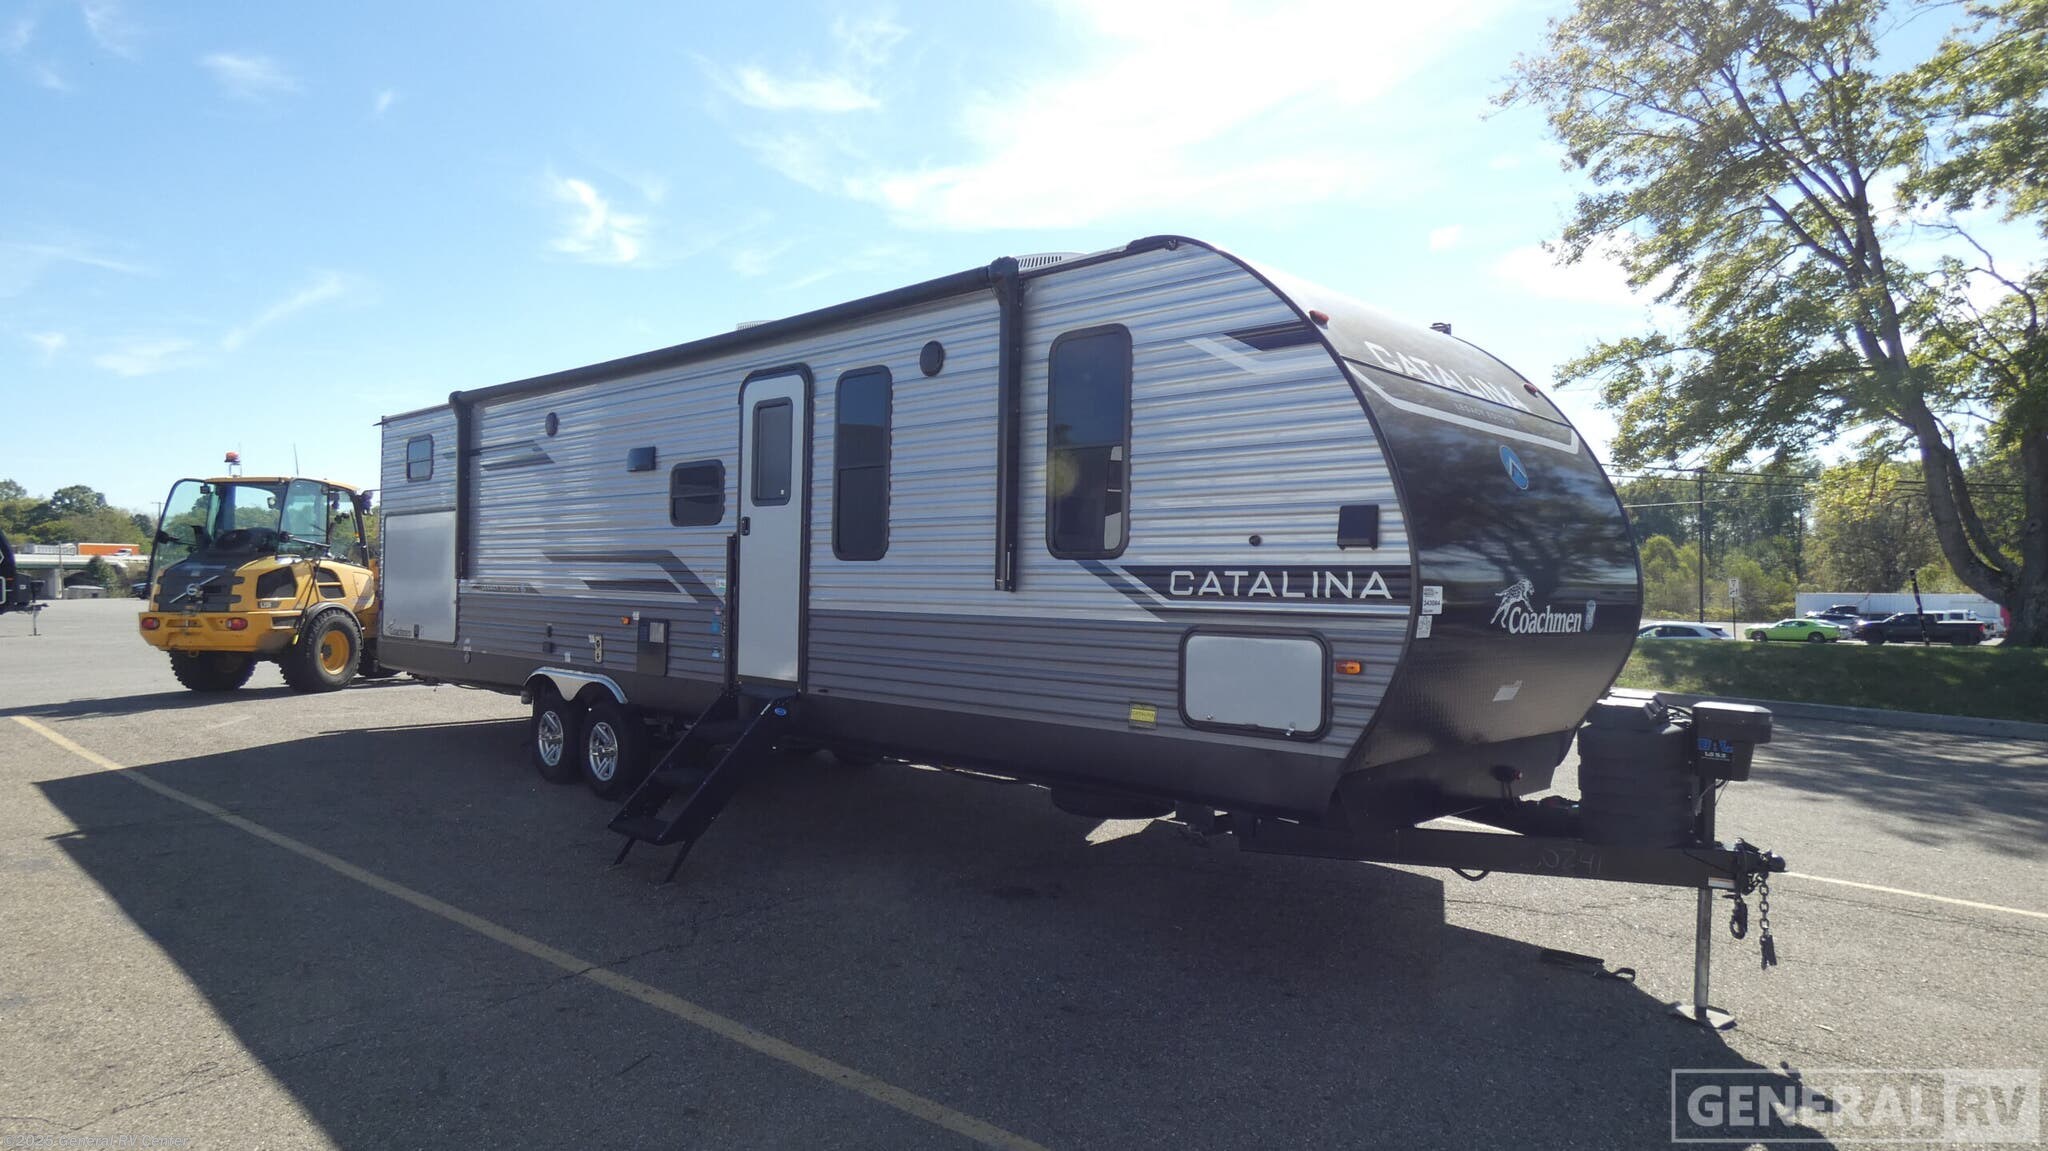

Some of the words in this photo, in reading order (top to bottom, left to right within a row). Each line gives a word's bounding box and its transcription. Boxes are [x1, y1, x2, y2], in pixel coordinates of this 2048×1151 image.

[1364, 340, 1532, 412] CATALINA
[1169, 570, 1393, 600] CATALINA
[1508, 604, 1582, 634] Coachmen
